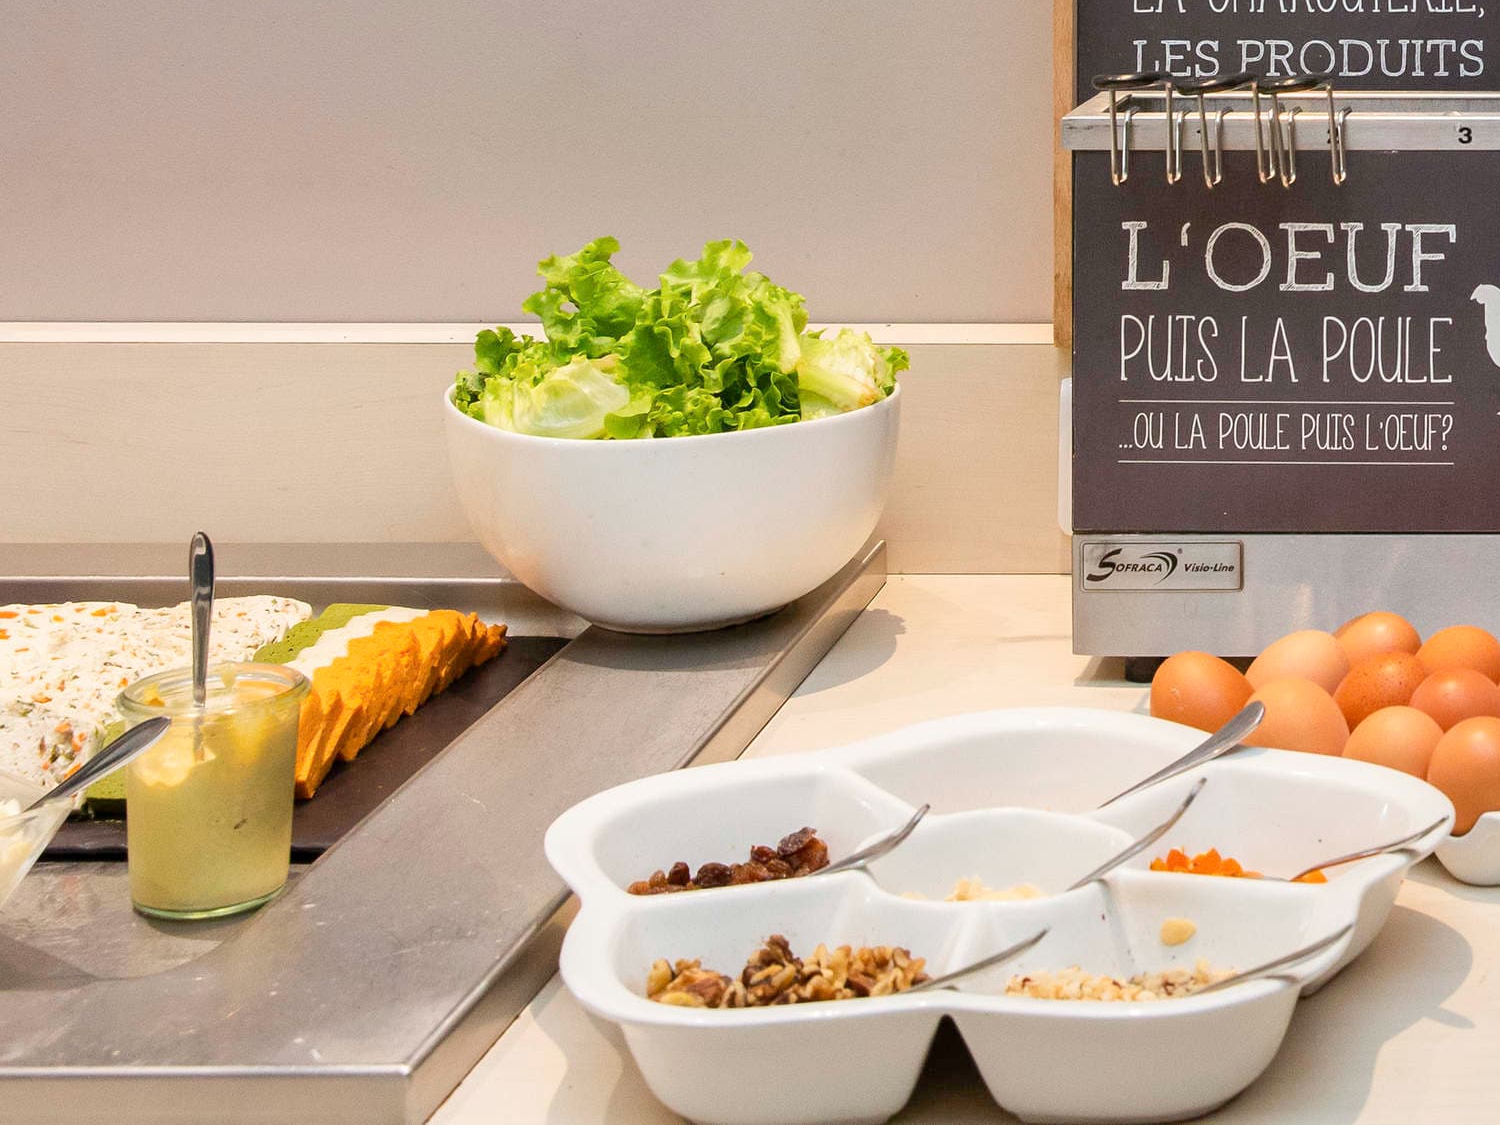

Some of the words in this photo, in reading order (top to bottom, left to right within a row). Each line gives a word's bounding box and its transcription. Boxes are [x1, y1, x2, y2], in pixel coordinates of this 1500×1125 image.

[1134, 39, 1220, 77] LES
[1236, 39, 1485, 78] PRODUITS
[1457, 126, 1473, 144] 3
[1120, 315, 1219, 383] PUIS
[1240, 316, 1299, 383] LA
[1322, 316, 1453, 384] POULE
[1118, 412, 1164, 450] ...OU
[1174, 413, 1207, 450] LA
[1219, 413, 1290, 450] POULE
[1301, 414, 1355, 451] PUIS
[1365, 414, 1454, 452] L'OEUF?
[1086, 547, 1163, 582] SOFRACA
